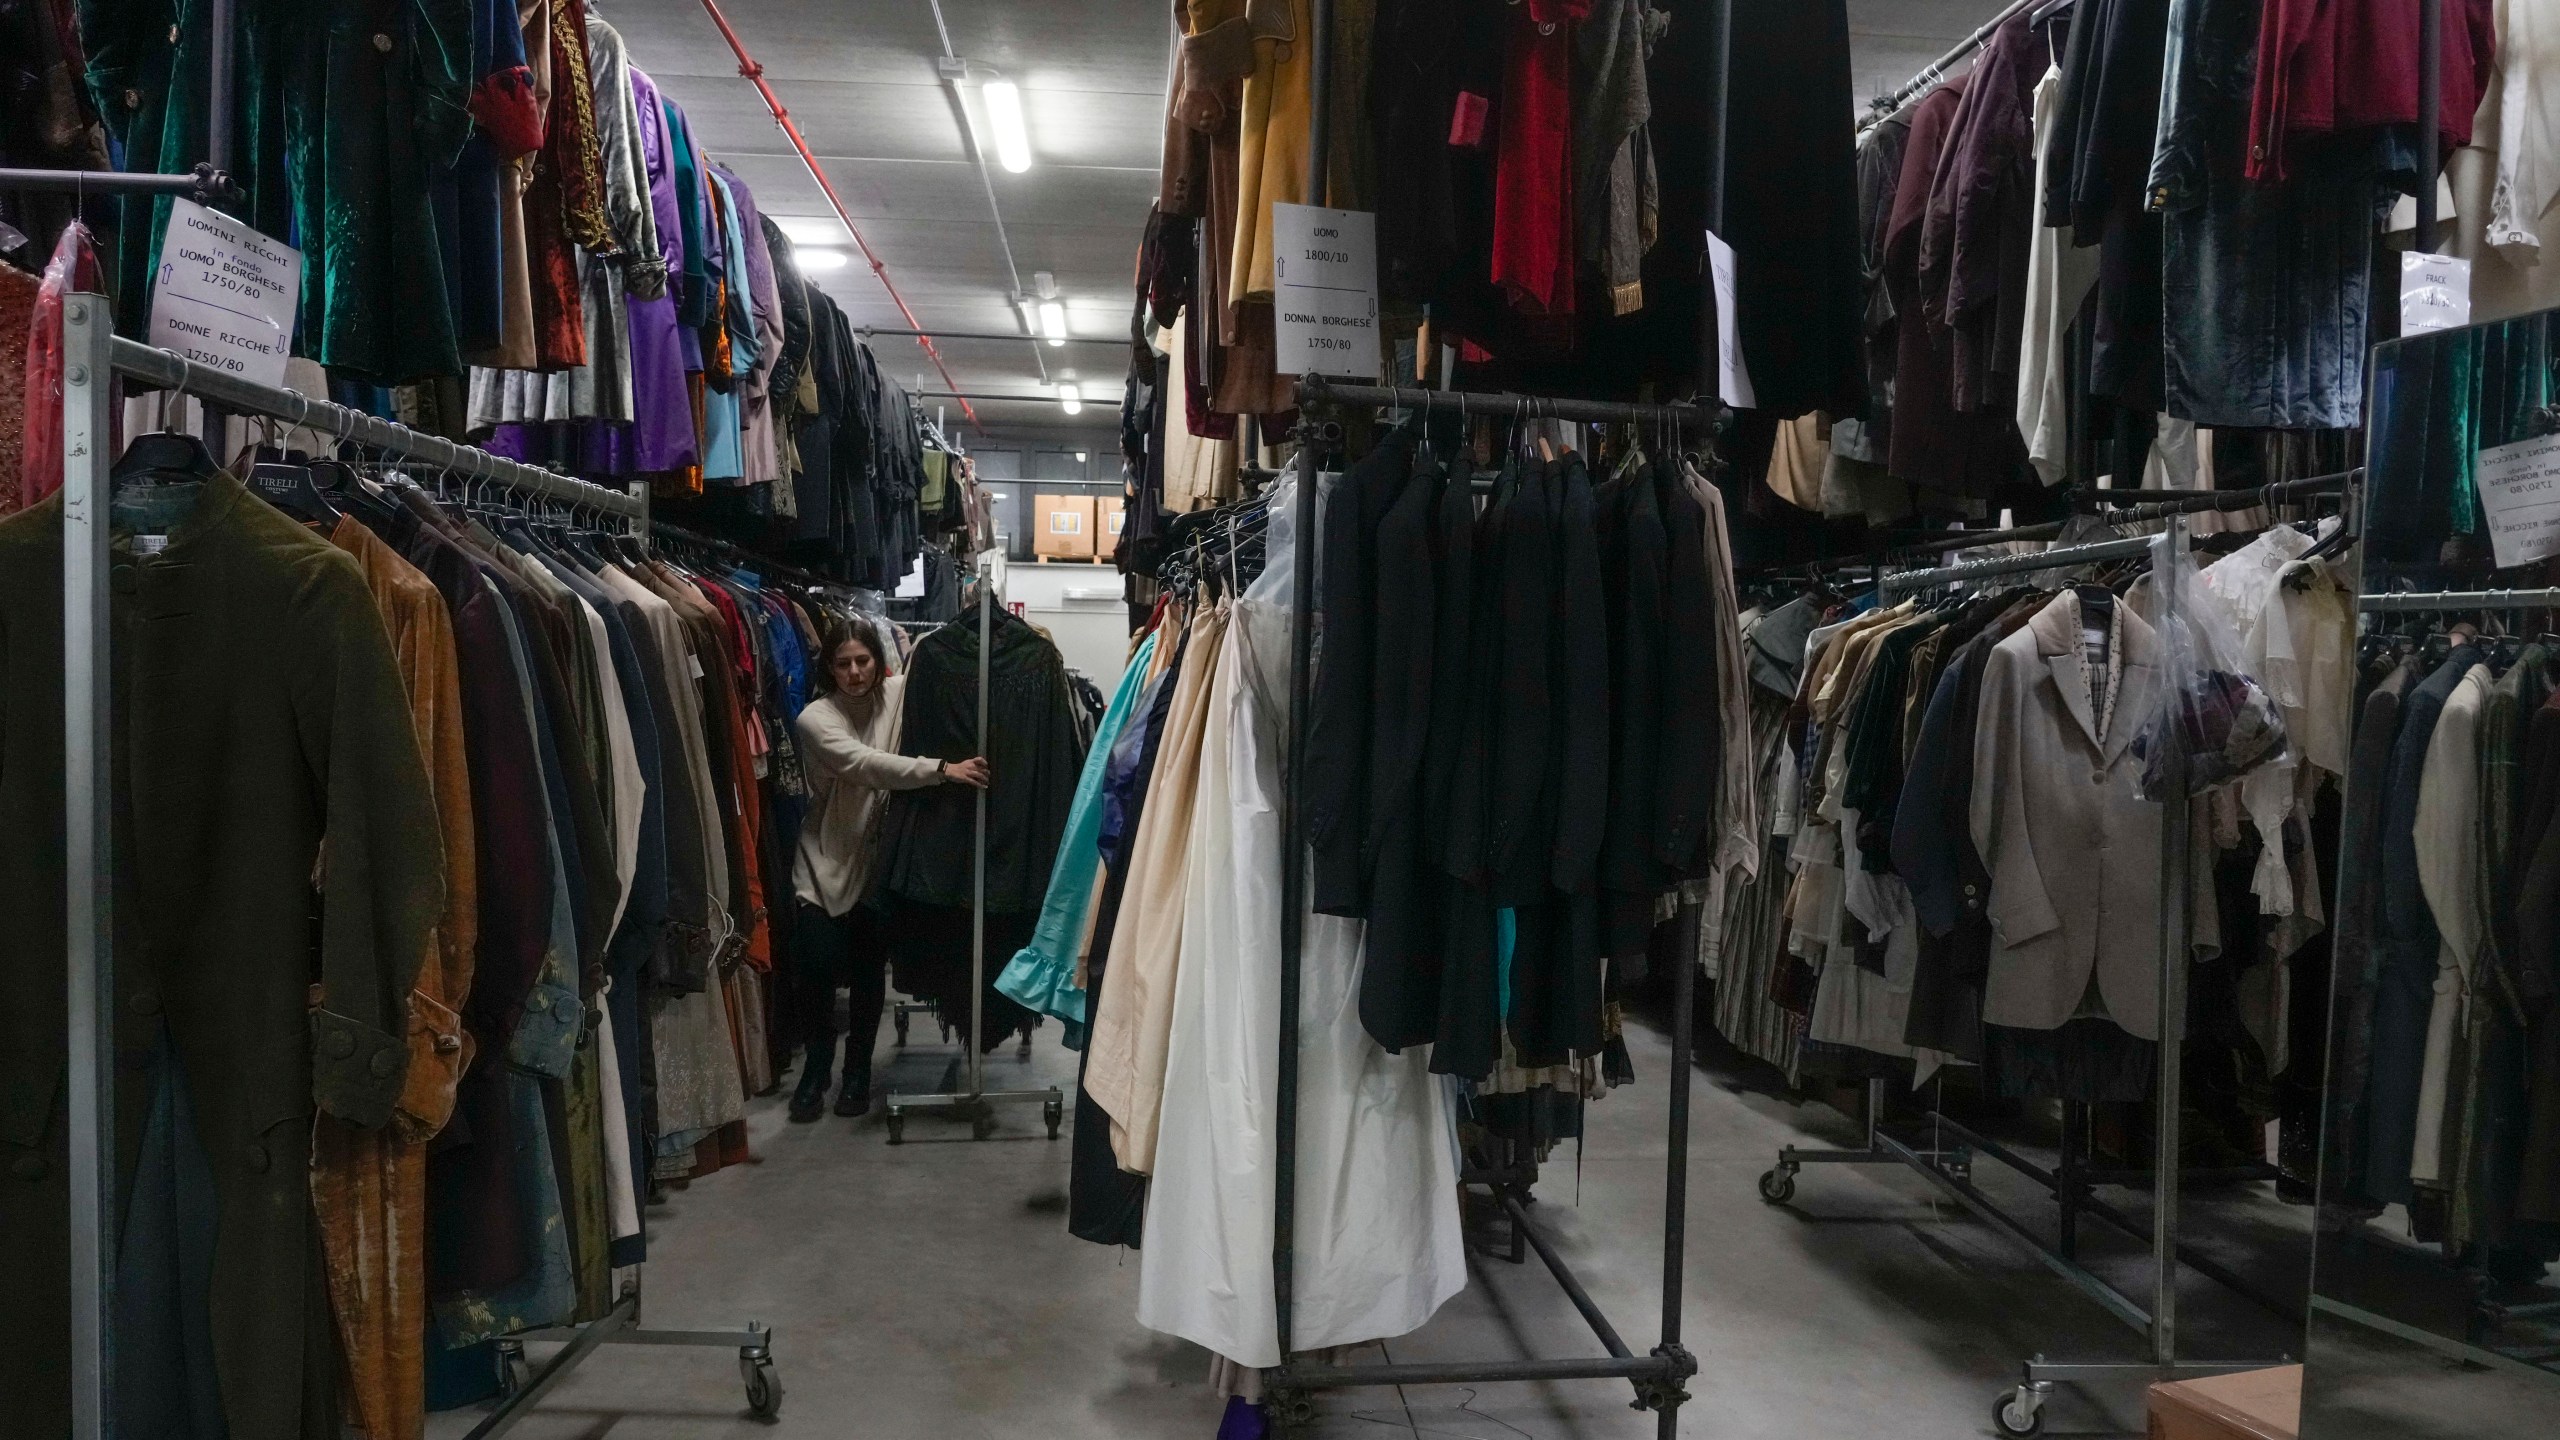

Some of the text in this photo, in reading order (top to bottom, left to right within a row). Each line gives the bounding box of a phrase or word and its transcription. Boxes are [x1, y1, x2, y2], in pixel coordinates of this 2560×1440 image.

[187, 217, 289, 267] UOMINI RICCHI
[1313, 227, 1339, 239] UOMO
[212, 247, 262, 274] in fondo
[1305, 250, 1349, 263] 1800/10
[179, 248, 286, 294] UOMO BORGHESE
[2425, 273, 2447, 285] FRACK
[202, 271, 261, 299] 1750/80
[1284, 313, 1372, 327] DONNA BORGHESE
[169, 318, 271, 355] DONNE RICCHE
[1308, 338, 1351, 351] 1750/80
[186, 349, 244, 372] 1750/80
[257, 476, 298, 489] TIRELLI
